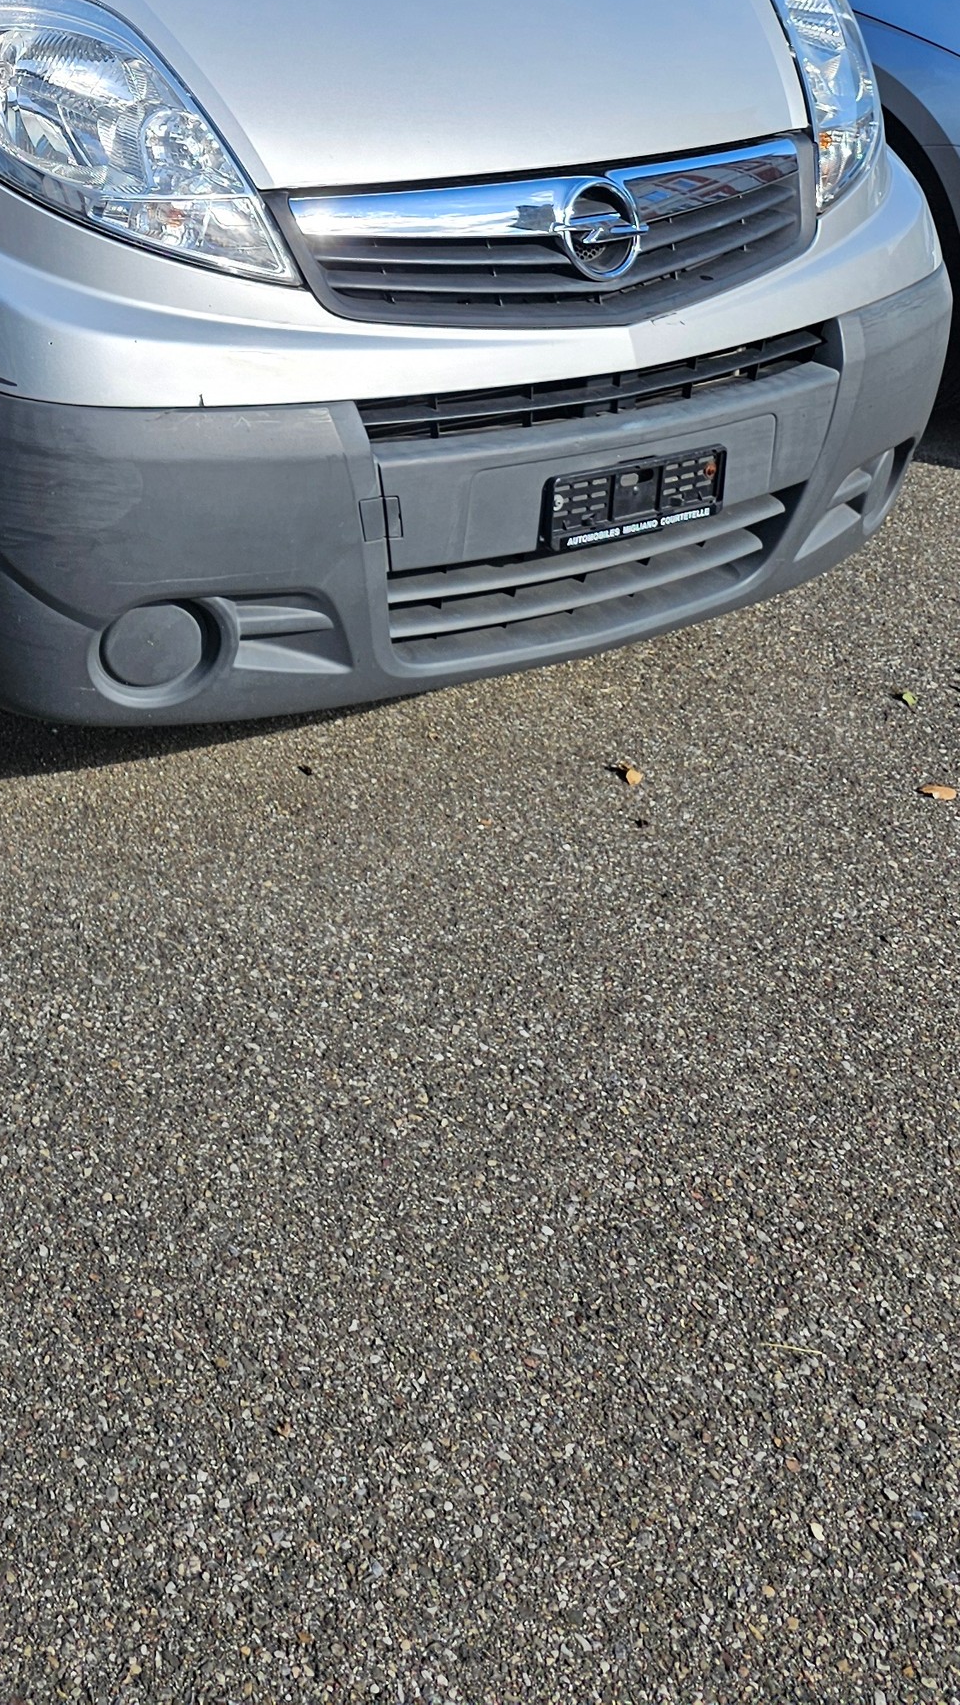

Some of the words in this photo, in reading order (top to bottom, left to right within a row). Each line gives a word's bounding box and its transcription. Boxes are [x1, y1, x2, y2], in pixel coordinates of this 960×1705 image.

[566, 527, 620, 546] AUTOMOBILES
[622, 519, 658, 535] MIGLIANO
[660, 507, 710, 526] COURTETELLE
